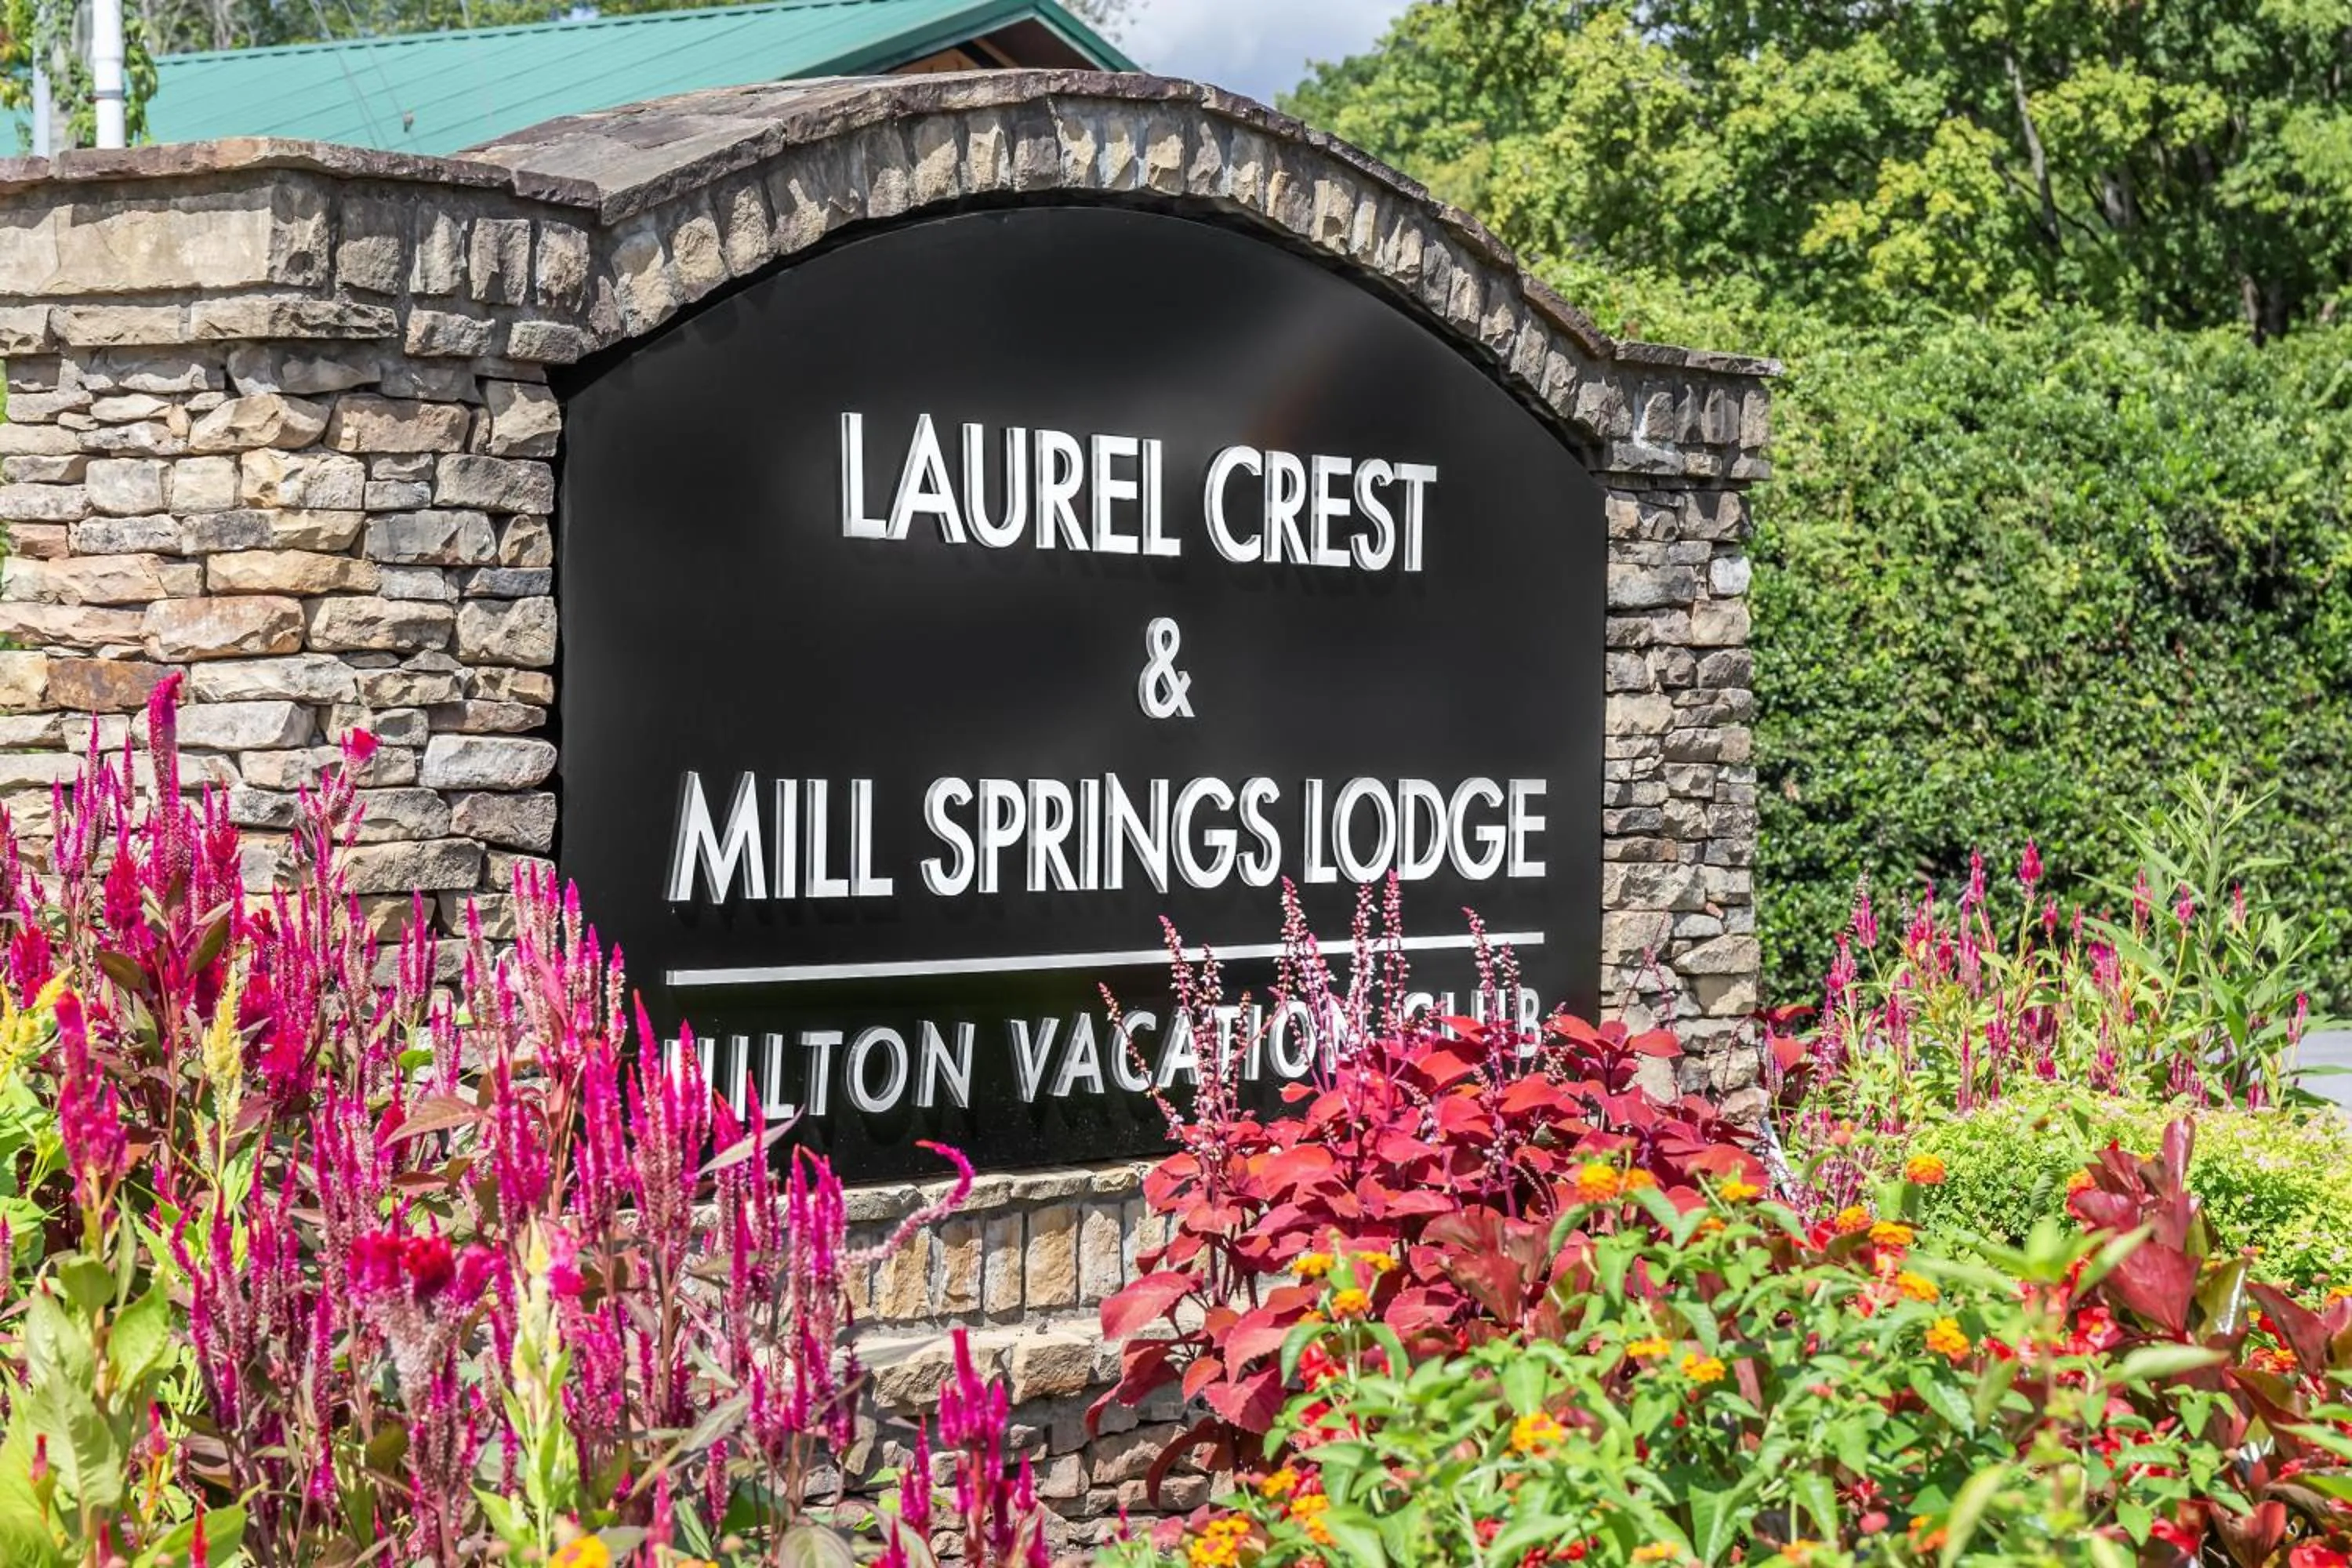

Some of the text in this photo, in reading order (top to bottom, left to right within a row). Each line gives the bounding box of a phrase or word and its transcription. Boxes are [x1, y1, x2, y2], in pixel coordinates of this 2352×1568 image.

[841, 412, 1437, 572] LAUREL CREST
[1138, 617, 1195, 718] &
[668, 771, 1547, 904] MILL SPRINGS LODGE
